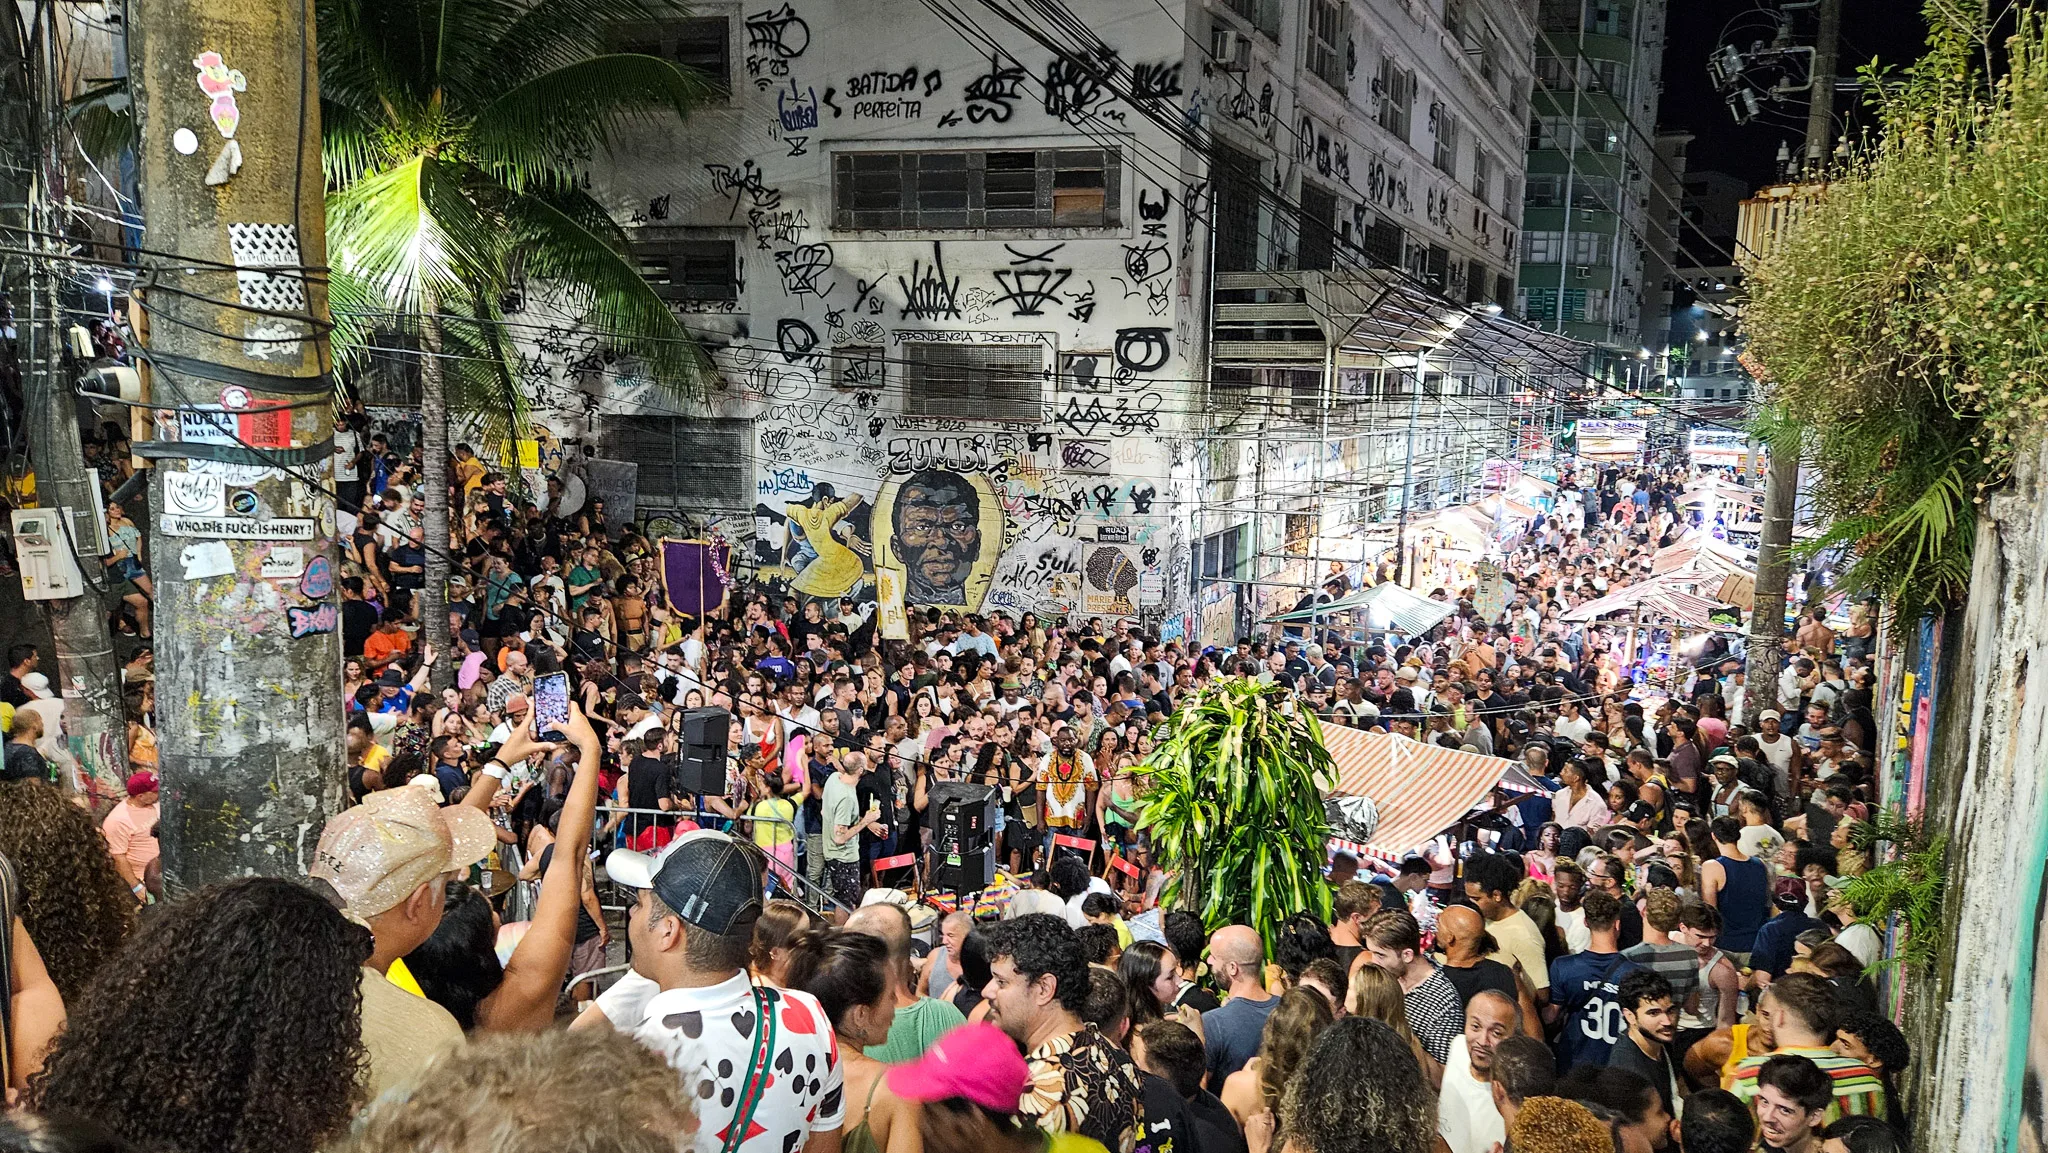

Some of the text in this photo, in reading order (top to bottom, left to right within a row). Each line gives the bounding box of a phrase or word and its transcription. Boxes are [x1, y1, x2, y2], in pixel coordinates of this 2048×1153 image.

[184, 428, 205, 437] WAS
[935, 419, 967, 432] 2020
[889, 434, 988, 475] ZUMBI
[175, 520, 205, 533] WHO
[225, 521, 255, 534] FUCK
[1580, 996, 1628, 1045] 30
